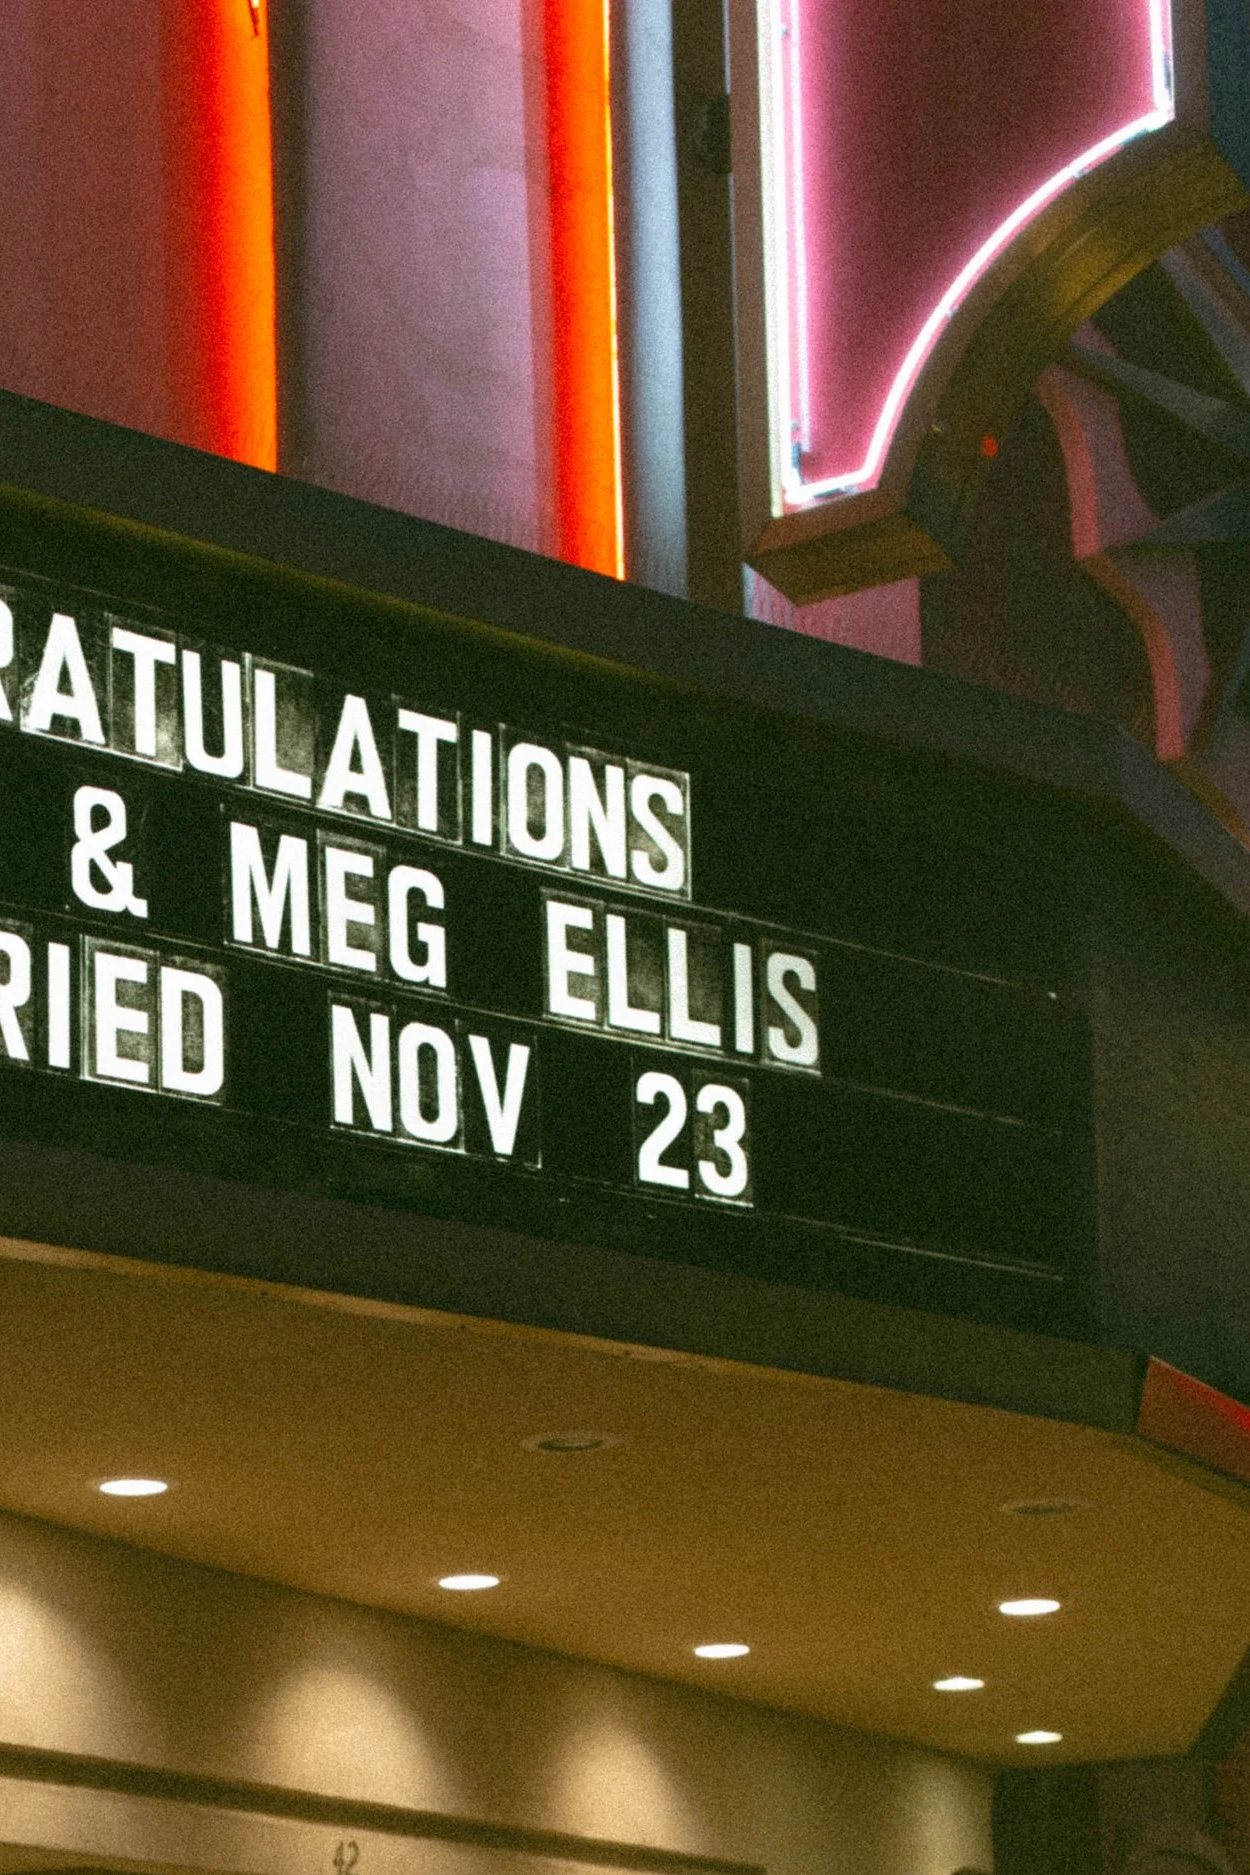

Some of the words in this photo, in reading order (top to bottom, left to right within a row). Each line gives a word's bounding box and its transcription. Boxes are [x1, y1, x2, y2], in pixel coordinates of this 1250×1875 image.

[70, 785, 148, 919] &
[229, 821, 447, 989] MEG
[545, 899, 818, 1066] ELLIS
[330, 1004, 531, 1156] NOV
[635, 1070, 748, 1198] 23
